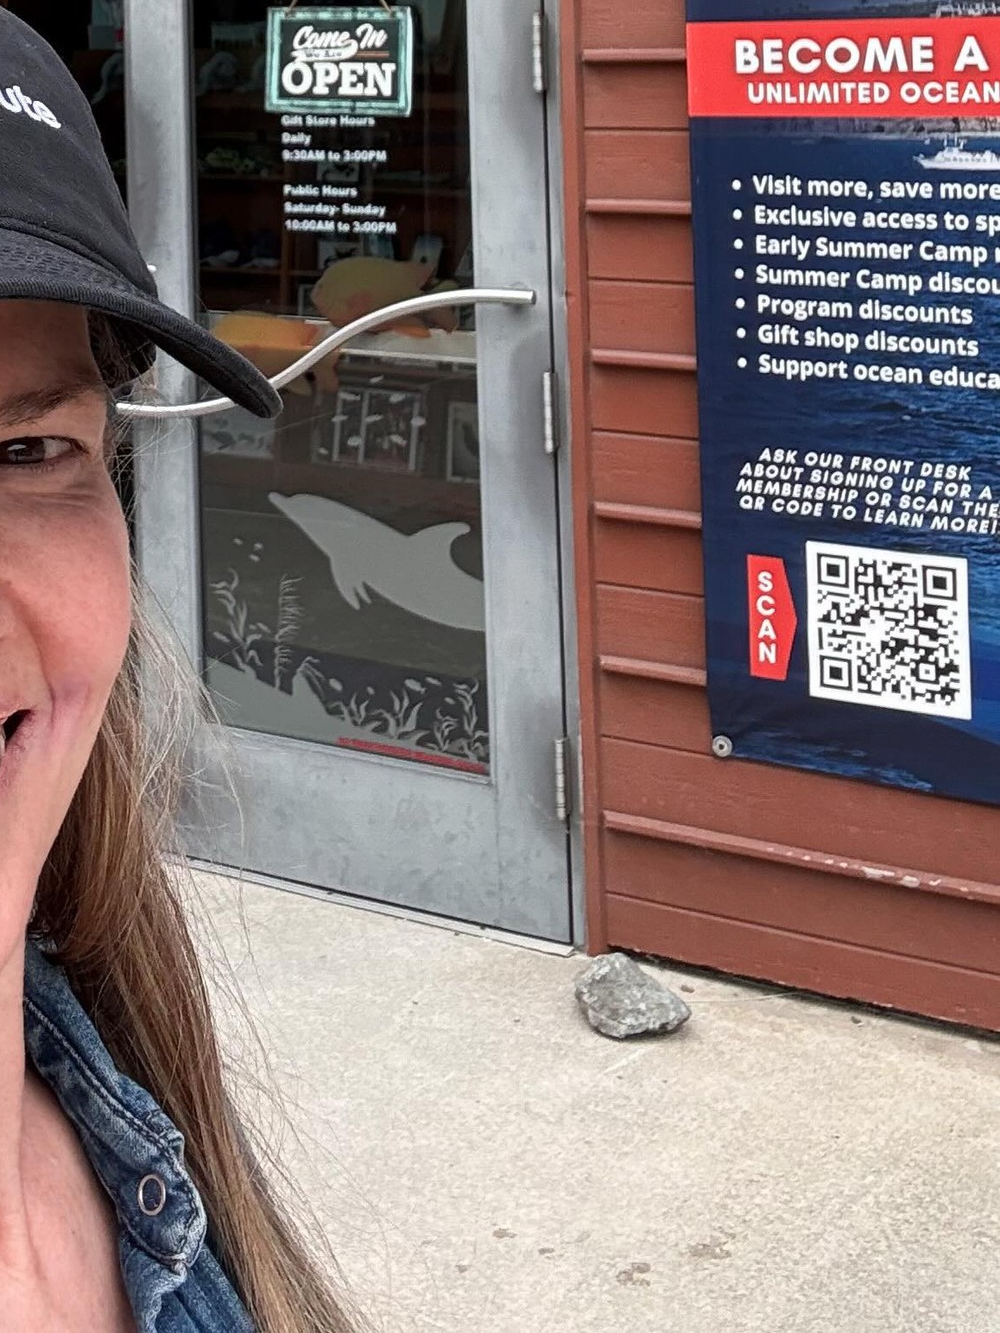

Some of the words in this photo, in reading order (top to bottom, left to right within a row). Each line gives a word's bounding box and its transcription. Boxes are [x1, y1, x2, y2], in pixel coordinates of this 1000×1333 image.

[292, 25, 358, 51] Come
[355, 23, 388, 49] In
[735, 35, 934, 74] BECOME
[954, 35, 989, 72] A
[282, 61, 396, 96] OPEN
[747, 80, 890, 104] UNLIMITED
[899, 80, 1000, 104] OCEAN
[281, 115, 303, 127] Gift
[305, 115, 337, 127] Store
[340, 115, 376, 127] Hours
[281, 132, 312, 146] Daily
[328, 151, 341, 161] to
[343, 149, 387, 162] 3:00PM
[283, 184, 320, 197] Public
[322, 185, 358, 198] Hours
[752, 174, 802, 195] Visit
[808, 180, 873, 200] more,
[880, 181, 933, 199] save
[342, 203, 386, 218] Sunday
[754, 205, 856, 227] Exclusive
[862, 211, 938, 230] access
[943, 211, 969, 231] to
[337, 221, 350, 232] to
[352, 221, 397, 234] 3:00PM
[755, 235, 810, 260] Early
[815, 237, 913, 259] Summer
[919, 240, 987, 267] Camp
[756, 264, 850, 287] Summer
[856, 269, 922, 296] Camp
[757, 294, 852, 321] Program
[859, 299, 973, 325] discounts
[758, 324, 799, 345] Gift
[804, 327, 858, 353] shop
[865, 330, 979, 356] discounts
[758, 354, 848, 381] Support
[853, 363, 922, 384] ocean
[758, 448, 798, 465] ASK
[804, 451, 844, 469] OUR
[850, 455, 914, 475] FRONT
[920, 462, 972, 481] DESK
[739, 462, 805, 481] ABOUT
[809, 468, 893, 489] SIGNING
[901, 477, 926, 494] UP
[932, 480, 972, 498] FOR
[978, 485, 992, 500] A
[735, 478, 859, 503] MEMBERSHIP
[865, 491, 892, 507] OR
[899, 494, 954, 514] SCAN
[962, 501, 999, 518] THE
[739, 495, 765, 511] QR
[771, 499, 823, 517] CODE
[832, 504, 857, 520] TO
[863, 507, 924, 528] LEARN
[930, 515, 998, 535] MORE!
[756, 571, 777, 664] SCAN
